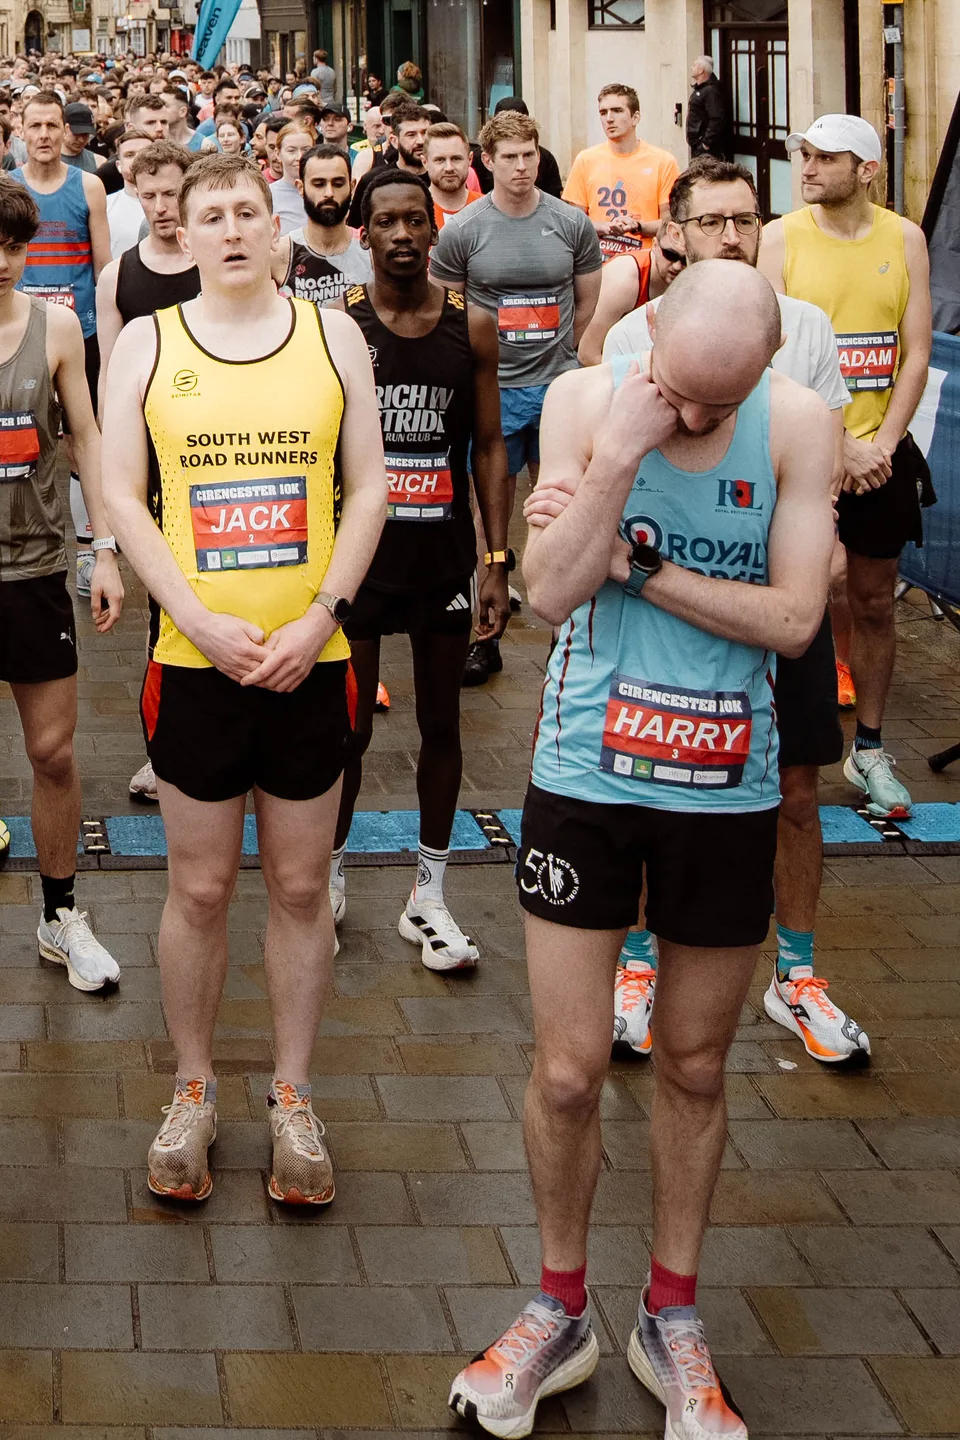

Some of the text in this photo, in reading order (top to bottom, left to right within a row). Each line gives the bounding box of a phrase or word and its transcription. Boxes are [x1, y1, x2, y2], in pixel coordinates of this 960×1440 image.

[295, 284, 352, 302] RUNNIN
[503, 298, 546, 306] CIRENCESTER
[836, 336, 883, 346] RENCESTER
[839, 349, 892, 367] ADAM
[863, 367, 870, 375] 16
[16, 415, 33, 426] 10K
[380, 409, 445, 433] TRIDE
[187, 431, 311, 448] SOUTH WEST
[385, 433, 406, 442] RUN
[406, 432, 431, 442] CLUB
[180, 451, 318, 468] ROAD RUNNERS
[384, 456, 447, 467] ENCESTER 10K
[386, 473, 438, 492] RICH
[196, 483, 300, 502] CIRENCESTER 10K
[406, 494, 411, 502] 7
[211, 504, 291, 534] JACK
[248, 534, 255, 543] 2
[667, 533, 764, 568] ROYAL
[618, 682, 743, 713] CIRENCESTER 10K
[613, 707, 746, 750] HARRY
[671, 749, 679, 759] 3
[555, 857, 571, 869] TCS
[537, 861, 548, 900] MARATHON
[569, 868, 579, 885] NEW
[565, 886, 579, 903] YORK
